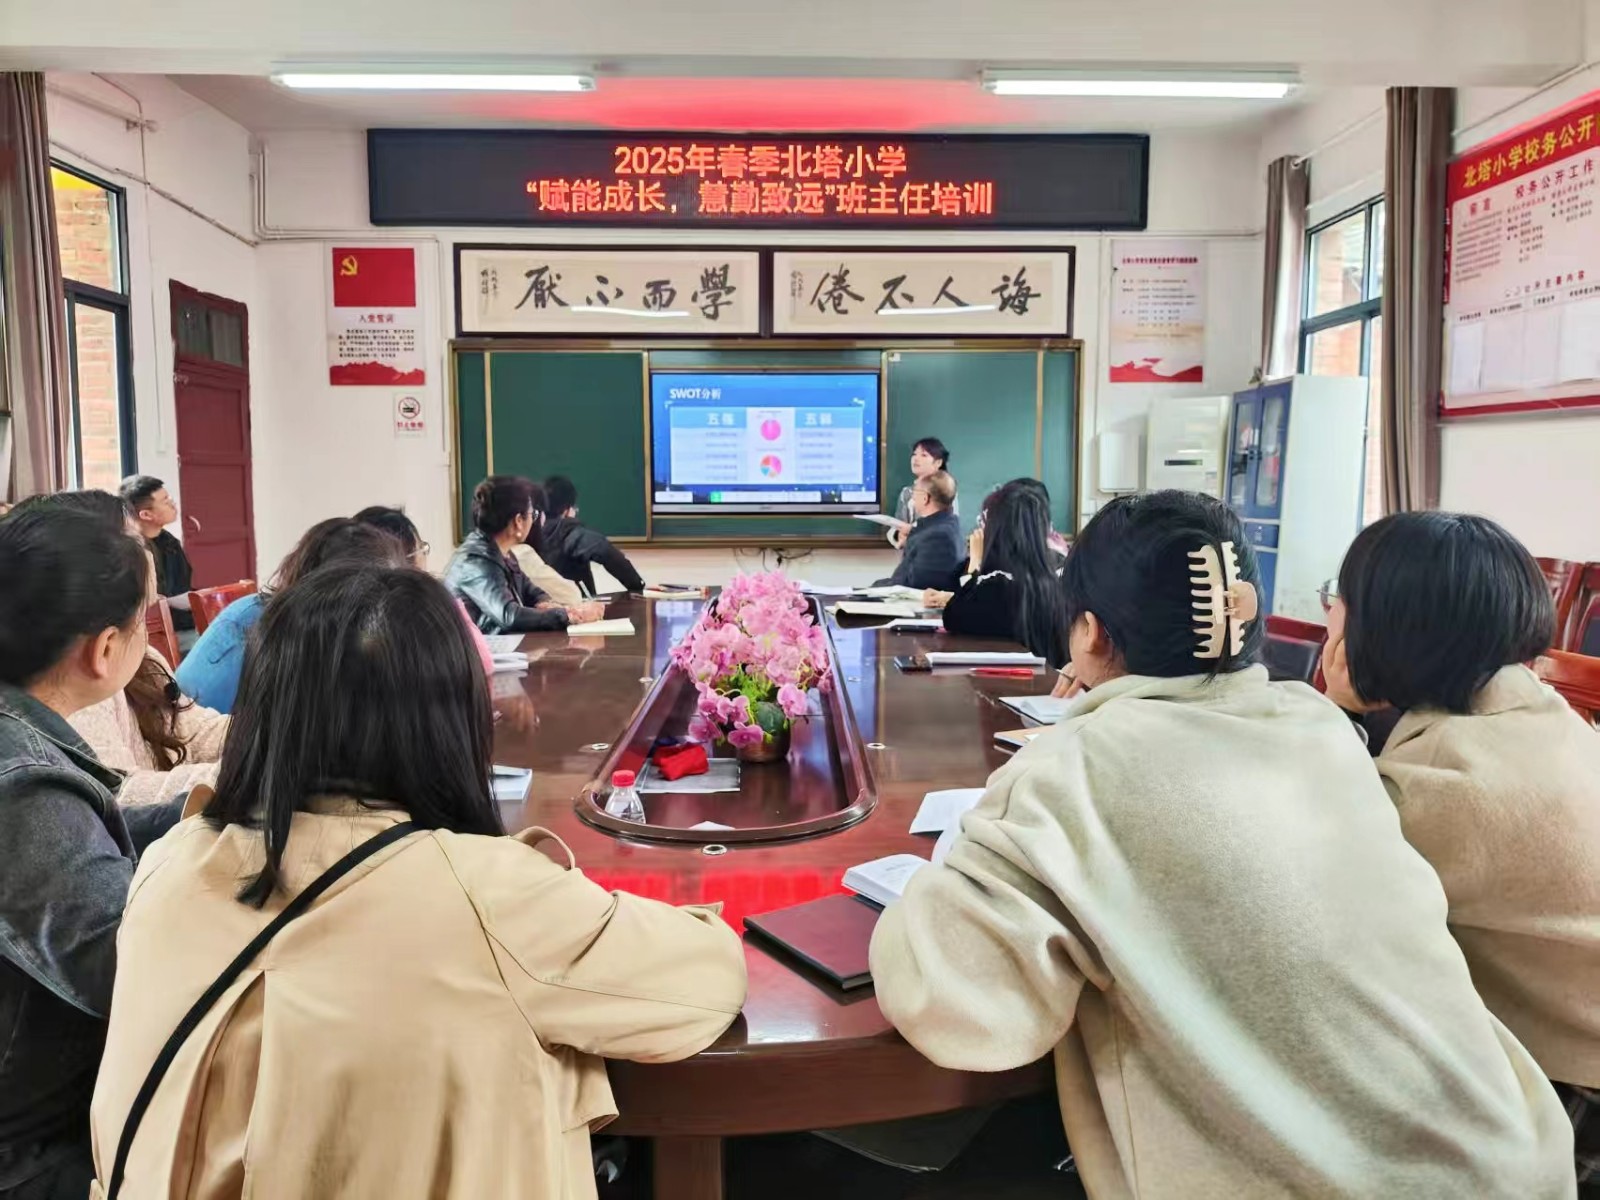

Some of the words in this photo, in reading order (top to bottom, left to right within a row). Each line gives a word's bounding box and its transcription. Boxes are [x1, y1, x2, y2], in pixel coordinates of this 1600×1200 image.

[614, 144, 907, 179] 2025年春季北塔小学
[1463, 113, 1600, 188] 北塔小学校务公开
[669, 388, 721, 400] SWOT分析
